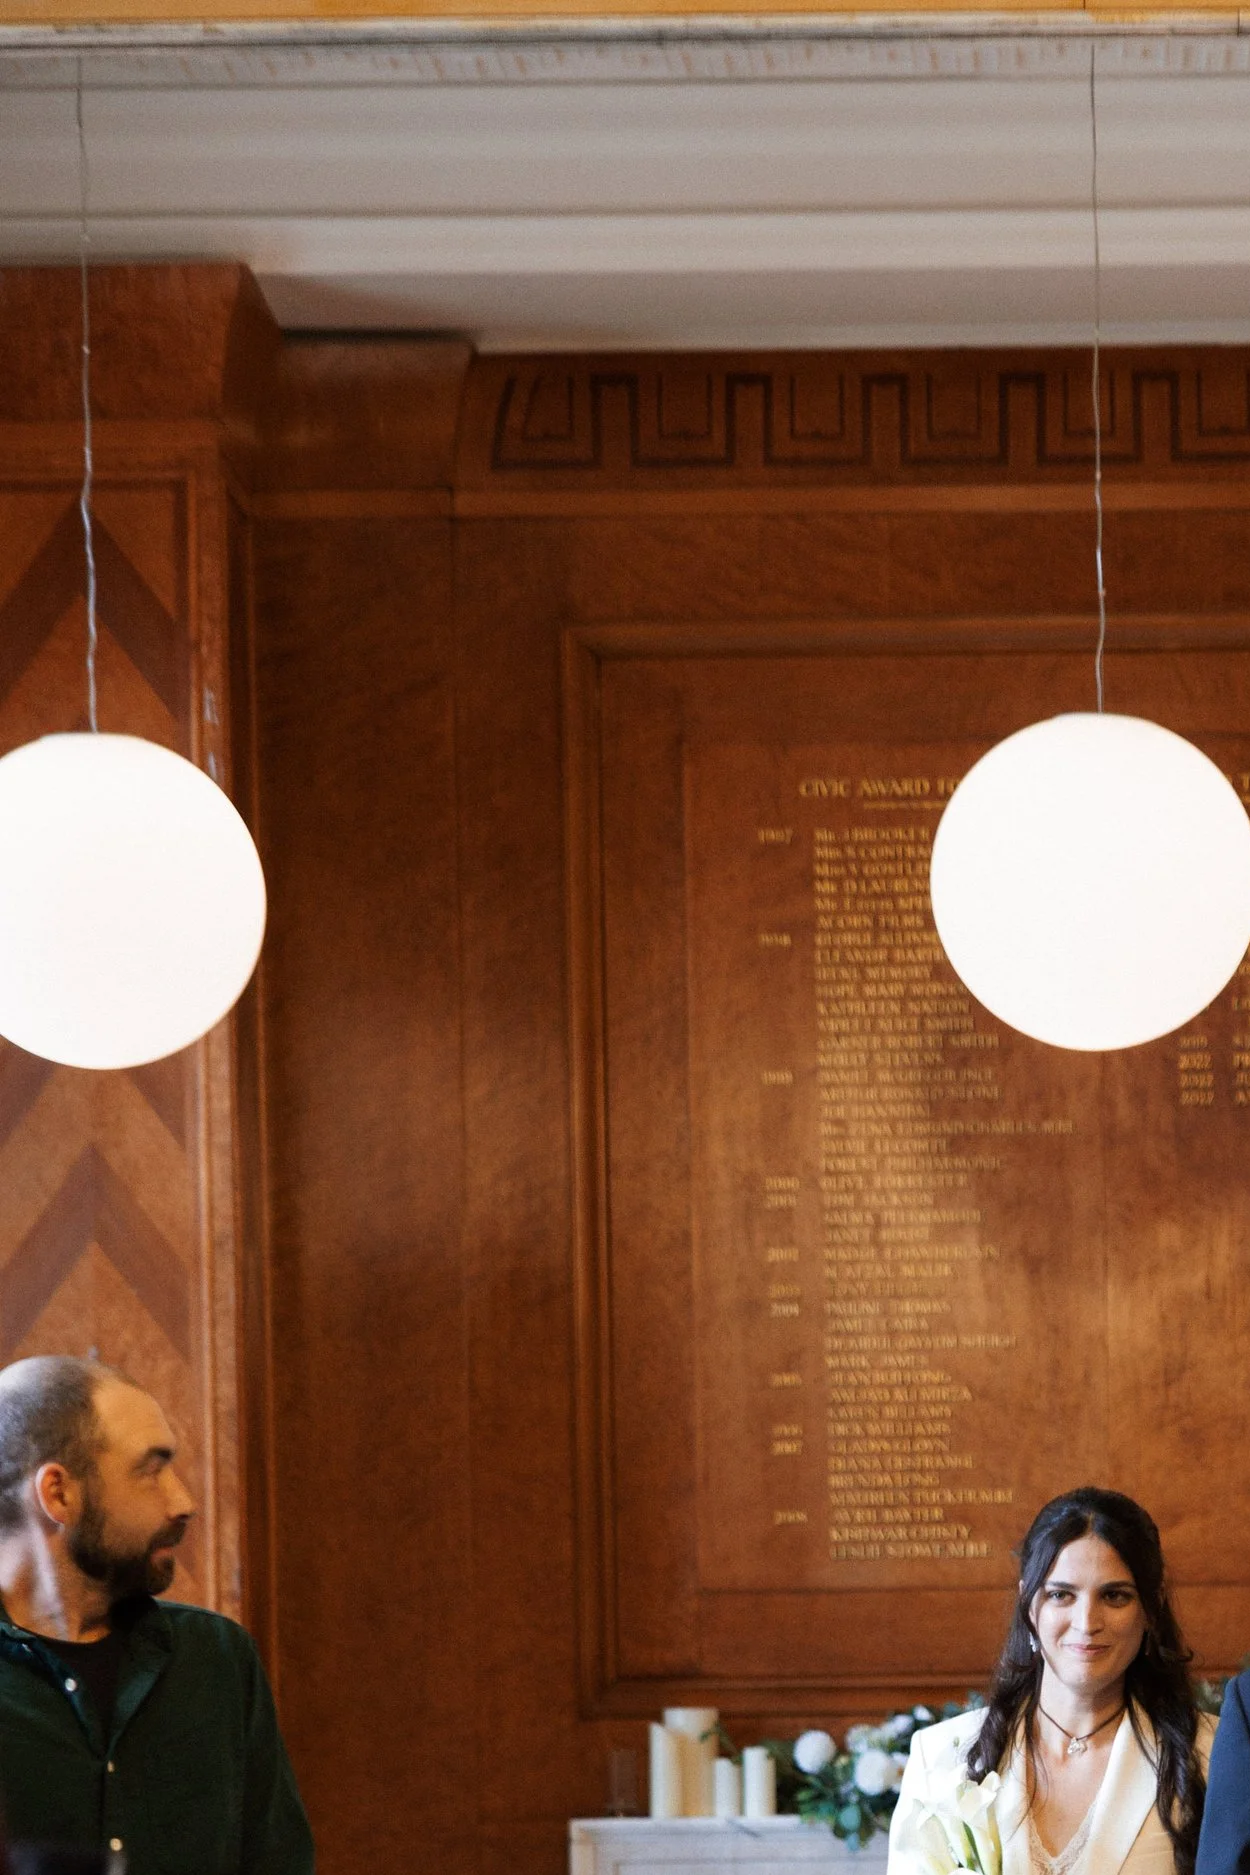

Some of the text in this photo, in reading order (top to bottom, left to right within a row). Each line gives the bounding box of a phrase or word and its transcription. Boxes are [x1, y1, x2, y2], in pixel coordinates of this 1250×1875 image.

[799, 778, 849, 797] CIVIC
[860, 778, 930, 797] AWARD
[817, 1000, 901, 1014] KATHLEEN
[924, 1016, 975, 1030] SMITH
[948, 1033, 999, 1047] SMITH
